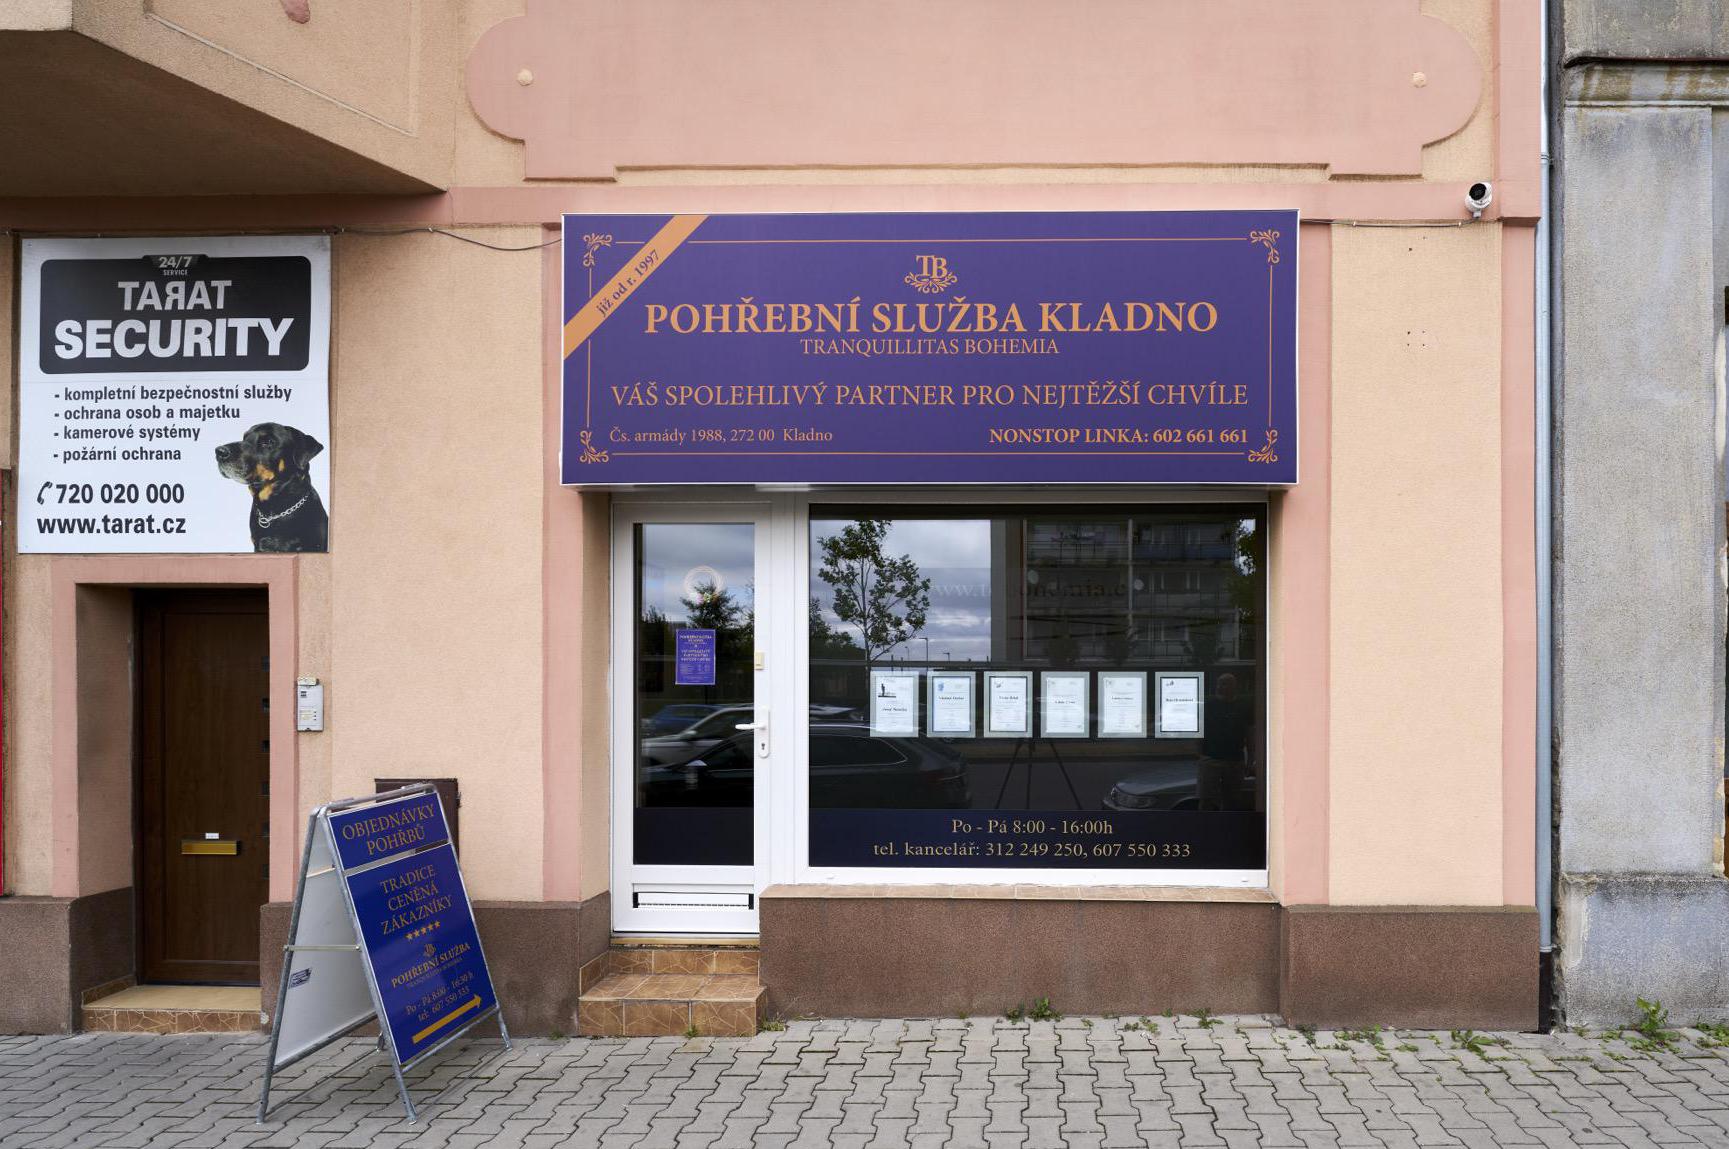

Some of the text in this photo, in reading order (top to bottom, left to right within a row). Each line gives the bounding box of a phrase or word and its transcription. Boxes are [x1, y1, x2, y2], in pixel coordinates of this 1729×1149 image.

[159, 256, 193, 269] 24/7
[596, 249, 659, 318] již od r. 1997
[646, 296, 1217, 334] POHŘEBNÍ SLUŽBA KLADNO
[55, 318, 294, 359] SECURITY
[800, 336, 1058, 357] TRANQUILLITAS BOHEMIA
[65, 385, 135, 402] kompletní
[141, 385, 238, 402] bezpečnostní
[244, 385, 292, 401] služby
[611, 381, 1248, 407] VÁŠ SPOLEHLIVÝ PARTNER PRO NEJTĚŽŠÍ CHVÍLE
[64, 406, 120, 420] ochrana
[126, 405, 161, 419] osob
[166, 409, 174, 418] a
[180, 405, 240, 421] majetku
[64, 424, 134, 439] kamerové
[139, 424, 200, 441] systémy
[609, 426, 832, 446] Čs. armády 1988, 272 00 Kladno
[990, 428, 1247, 444] NONSTOP LINKA: 602 661 661
[63, 446, 116, 464] požární
[122, 447, 181, 460] ochrana
[56, 484, 184, 503] 720 020 000
[37, 515, 186, 534] www.tarat.cz
[341, 803, 436, 840] OBJEDNÁVKY
[951, 819, 974, 832] Po
[988, 818, 1008, 834] Pá
[1013, 818, 1045, 836] 8:00
[1062, 818, 1112, 835] 16:00h
[366, 824, 425, 856] POHŘBŮ
[873, 842, 1192, 860] tel. kancelář: 312 249 250, 607 550 333
[379, 864, 437, 894] TRADICE
[387, 882, 439, 911] CENĚNÁ
[381, 895, 453, 935] ZÁKAZNÍKY
[392, 957, 439, 988] POHŘEBNÍ
[440, 942, 471, 962] SLUŽBA
